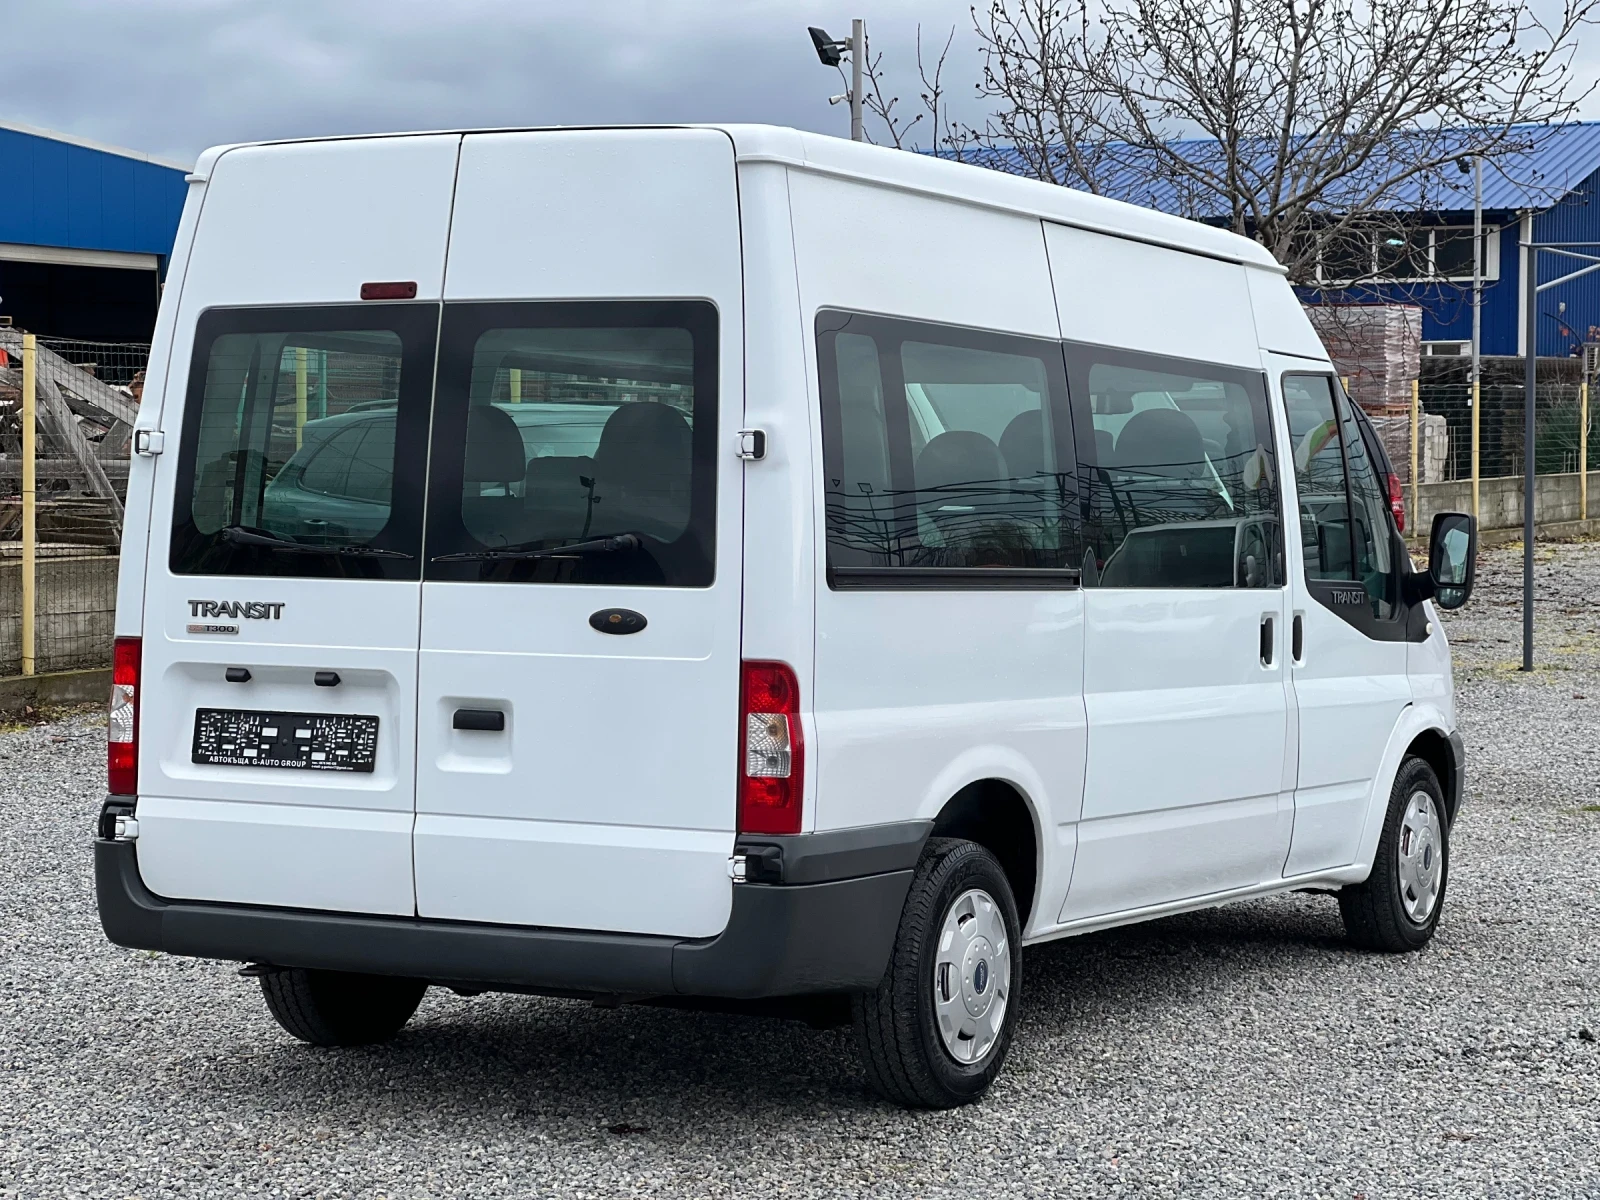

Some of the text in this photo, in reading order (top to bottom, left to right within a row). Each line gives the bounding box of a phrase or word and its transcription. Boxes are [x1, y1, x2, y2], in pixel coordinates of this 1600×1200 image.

[1331, 591, 1365, 604] TRANSIT
[188, 600, 285, 619] TRANSIT
[209, 756, 249, 765] АВТОКЪЩА
[252, 758, 280, 767] G-AUTO
[281, 760, 307, 768] GROUP
